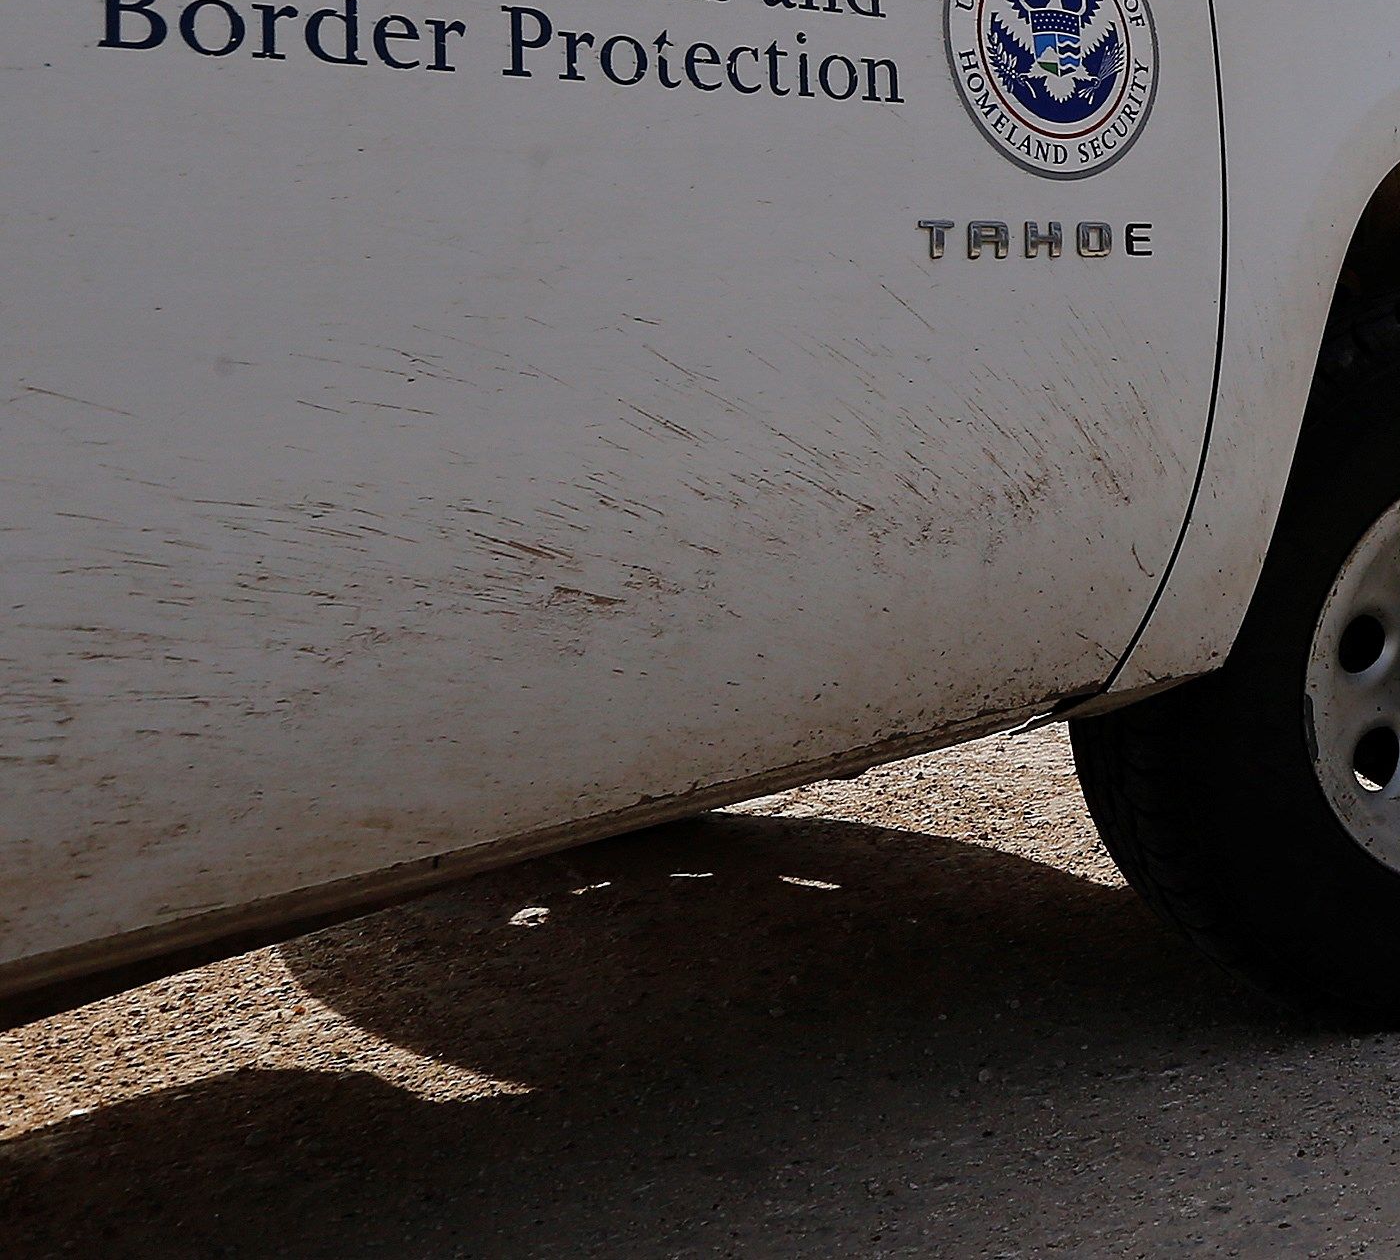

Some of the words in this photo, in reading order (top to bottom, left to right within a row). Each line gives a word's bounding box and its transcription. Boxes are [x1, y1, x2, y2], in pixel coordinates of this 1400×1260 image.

[501, 5, 904, 104] Protection
[958, 48, 1069, 165] HOMELAND
[1079, 58, 1150, 165] SECURITY
[917, 220, 1153, 259] TAHOE
